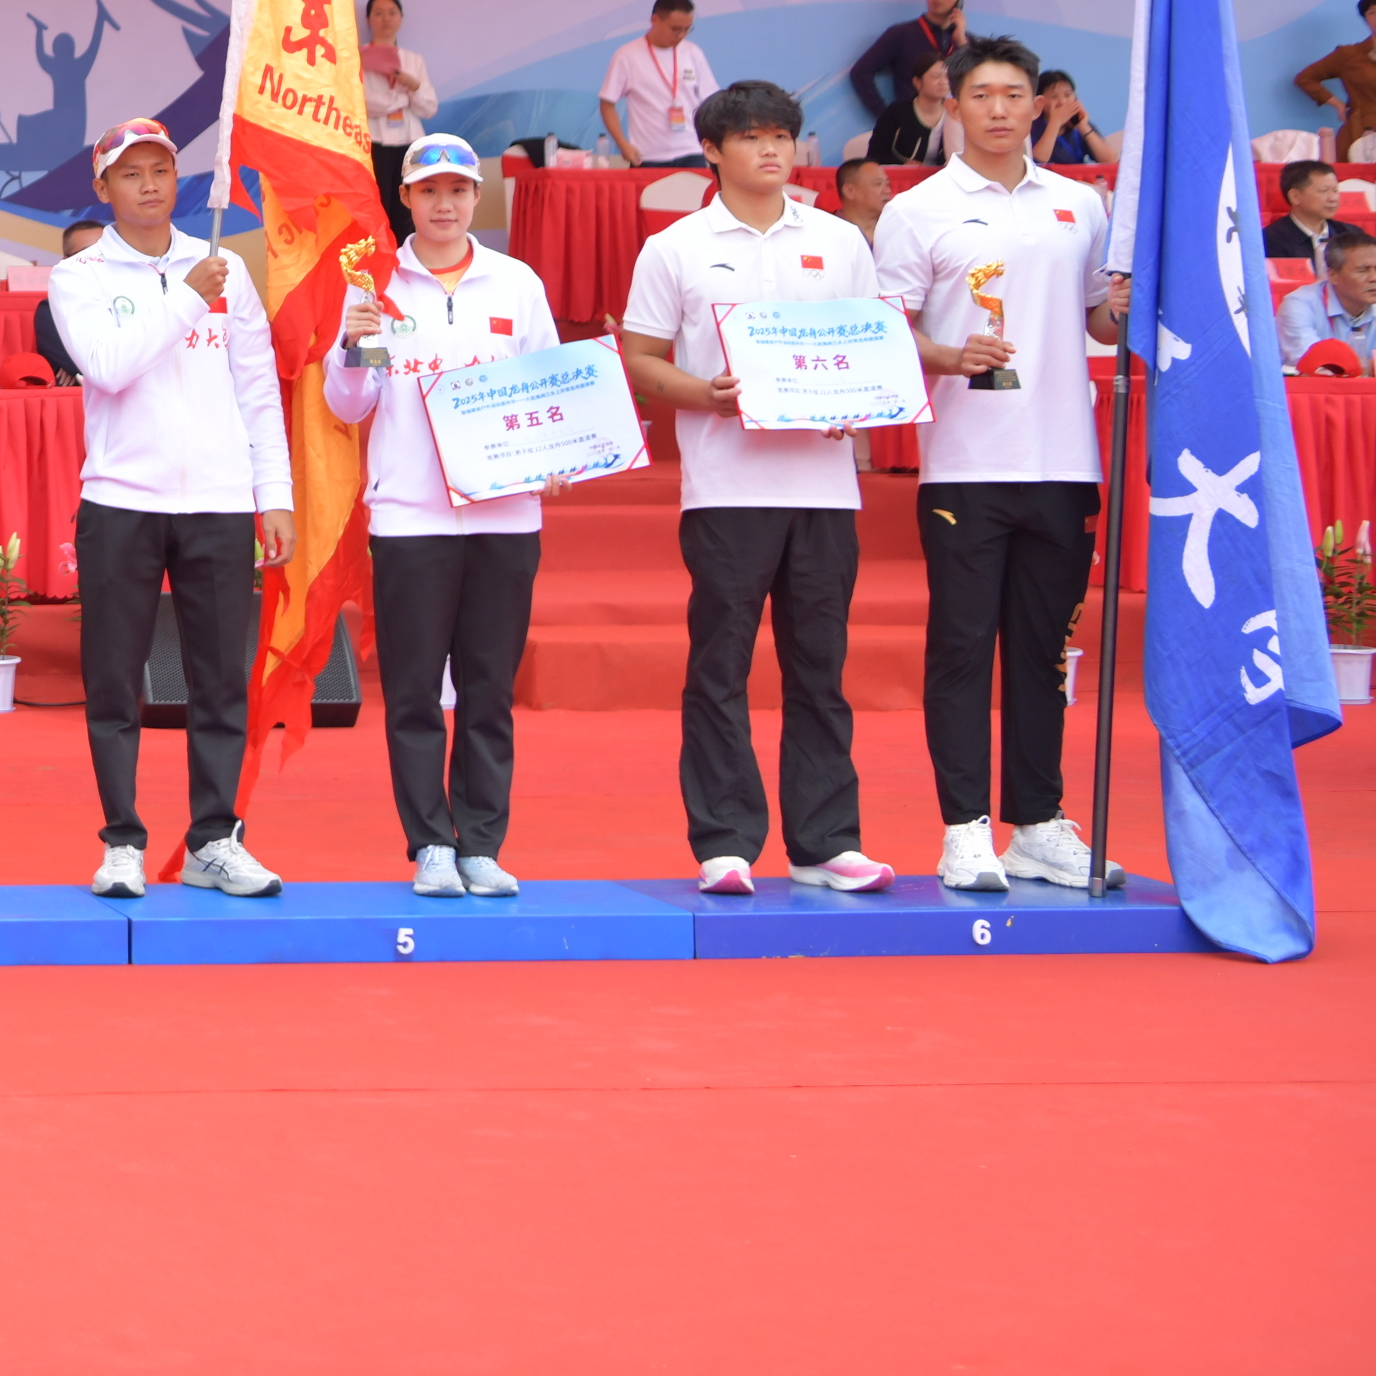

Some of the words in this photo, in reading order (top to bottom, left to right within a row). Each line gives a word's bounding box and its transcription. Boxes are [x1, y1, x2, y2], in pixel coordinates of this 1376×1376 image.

[258, 63, 372, 155] Northeas
[792, 354, 851, 370] 第六名
[451, 364, 599, 410] 2025年中国龙舟公开赛总决赛
[502, 405, 565, 432] 第五名
[396, 928, 415, 956] 5
[972, 919, 992, 946] 6
